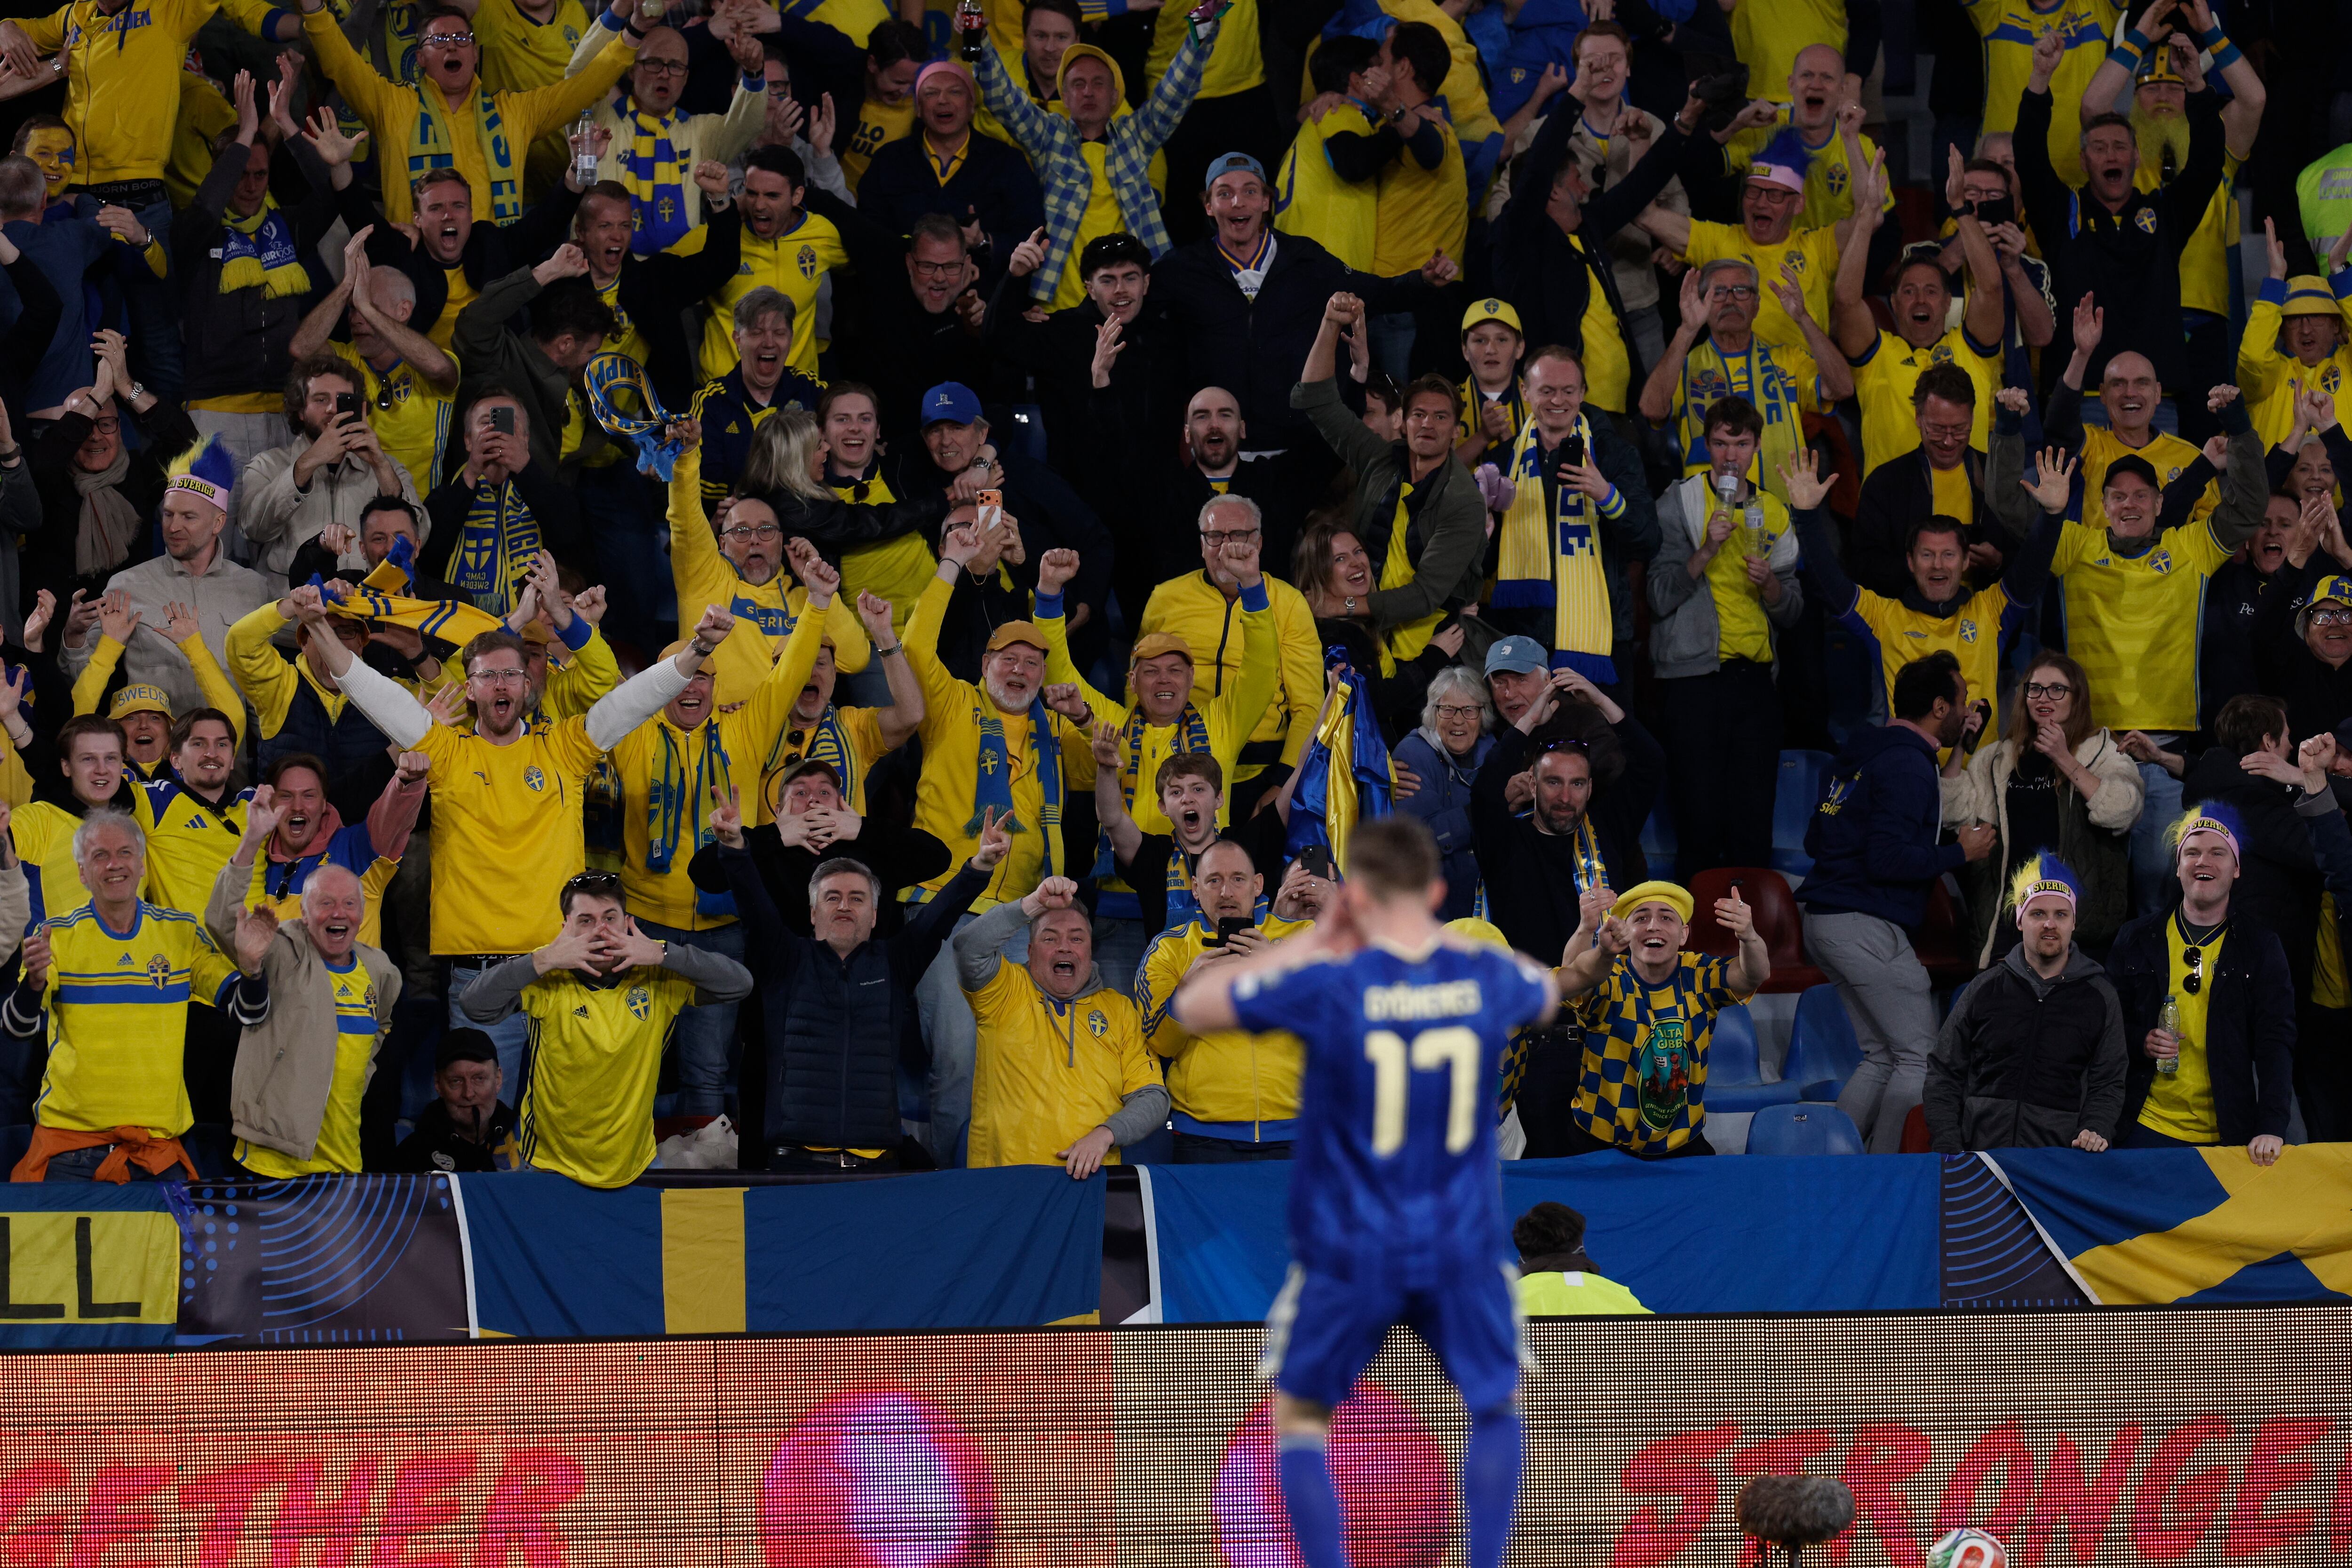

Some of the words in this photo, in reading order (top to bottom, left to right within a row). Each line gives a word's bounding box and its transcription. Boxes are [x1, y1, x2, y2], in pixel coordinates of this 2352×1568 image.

[90, 184, 128, 193] BJÖRN
[177, 478, 215, 499] SVERIGE
[2192, 820, 2229, 838] SVERIGE
[2034, 882, 2071, 897] SVERIGE
[1364, 1025, 1481, 1159] 17
[1611, 1414, 2352, 1568] STRONGE
